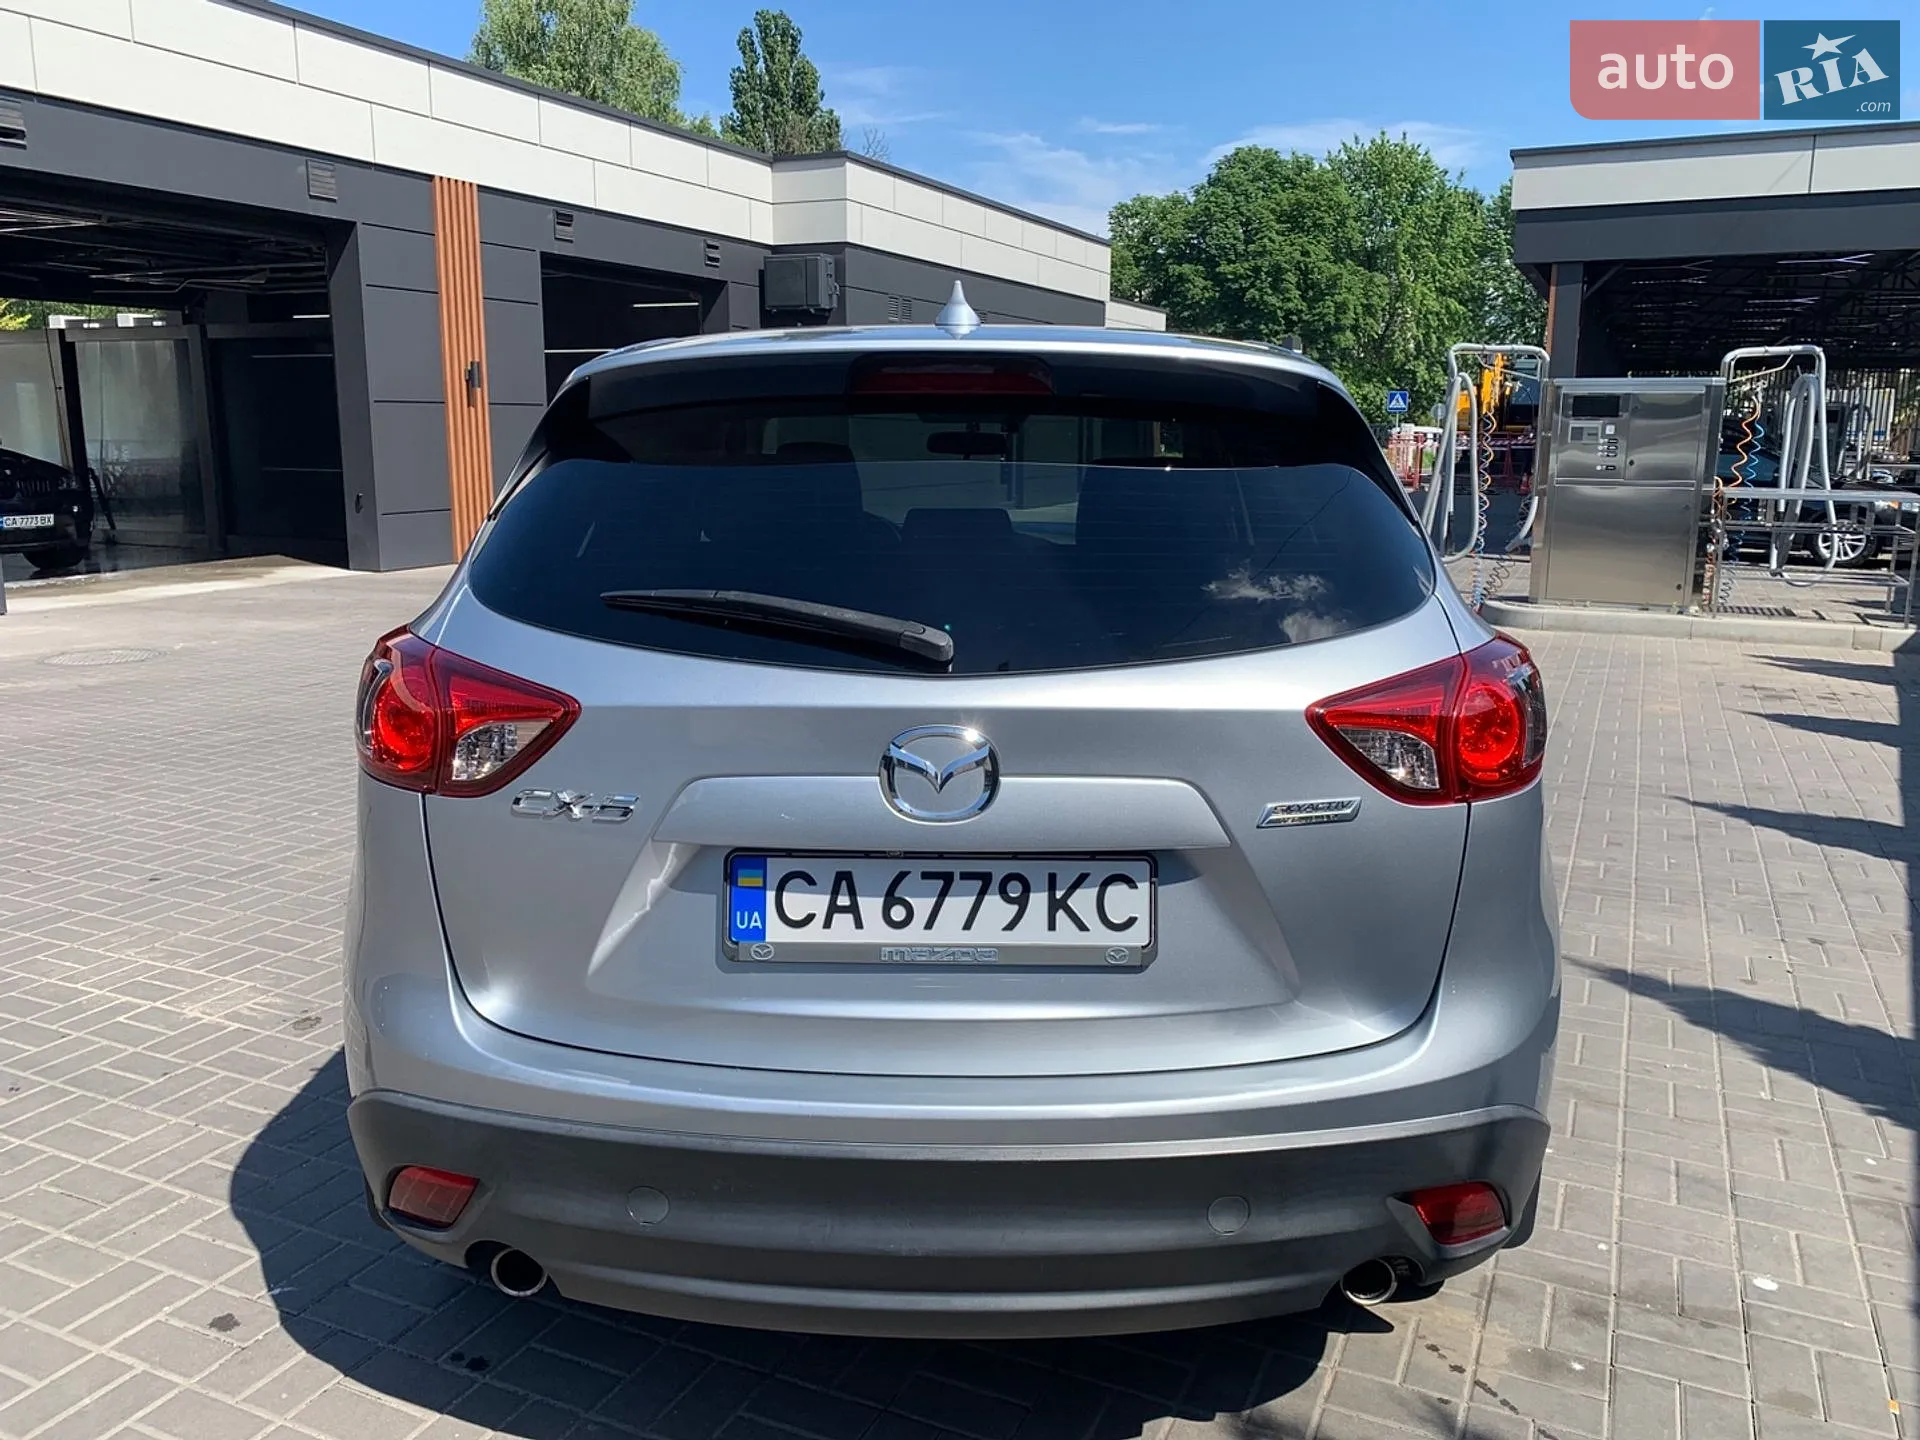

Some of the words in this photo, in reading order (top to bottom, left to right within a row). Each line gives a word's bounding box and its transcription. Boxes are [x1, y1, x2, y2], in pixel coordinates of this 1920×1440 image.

[511, 789, 640, 824] CX-5
[774, 870, 865, 931] CA
[881, 870, 1031, 932] 6779
[1046, 871, 1140, 932] KC
[736, 911, 763, 930] UA
